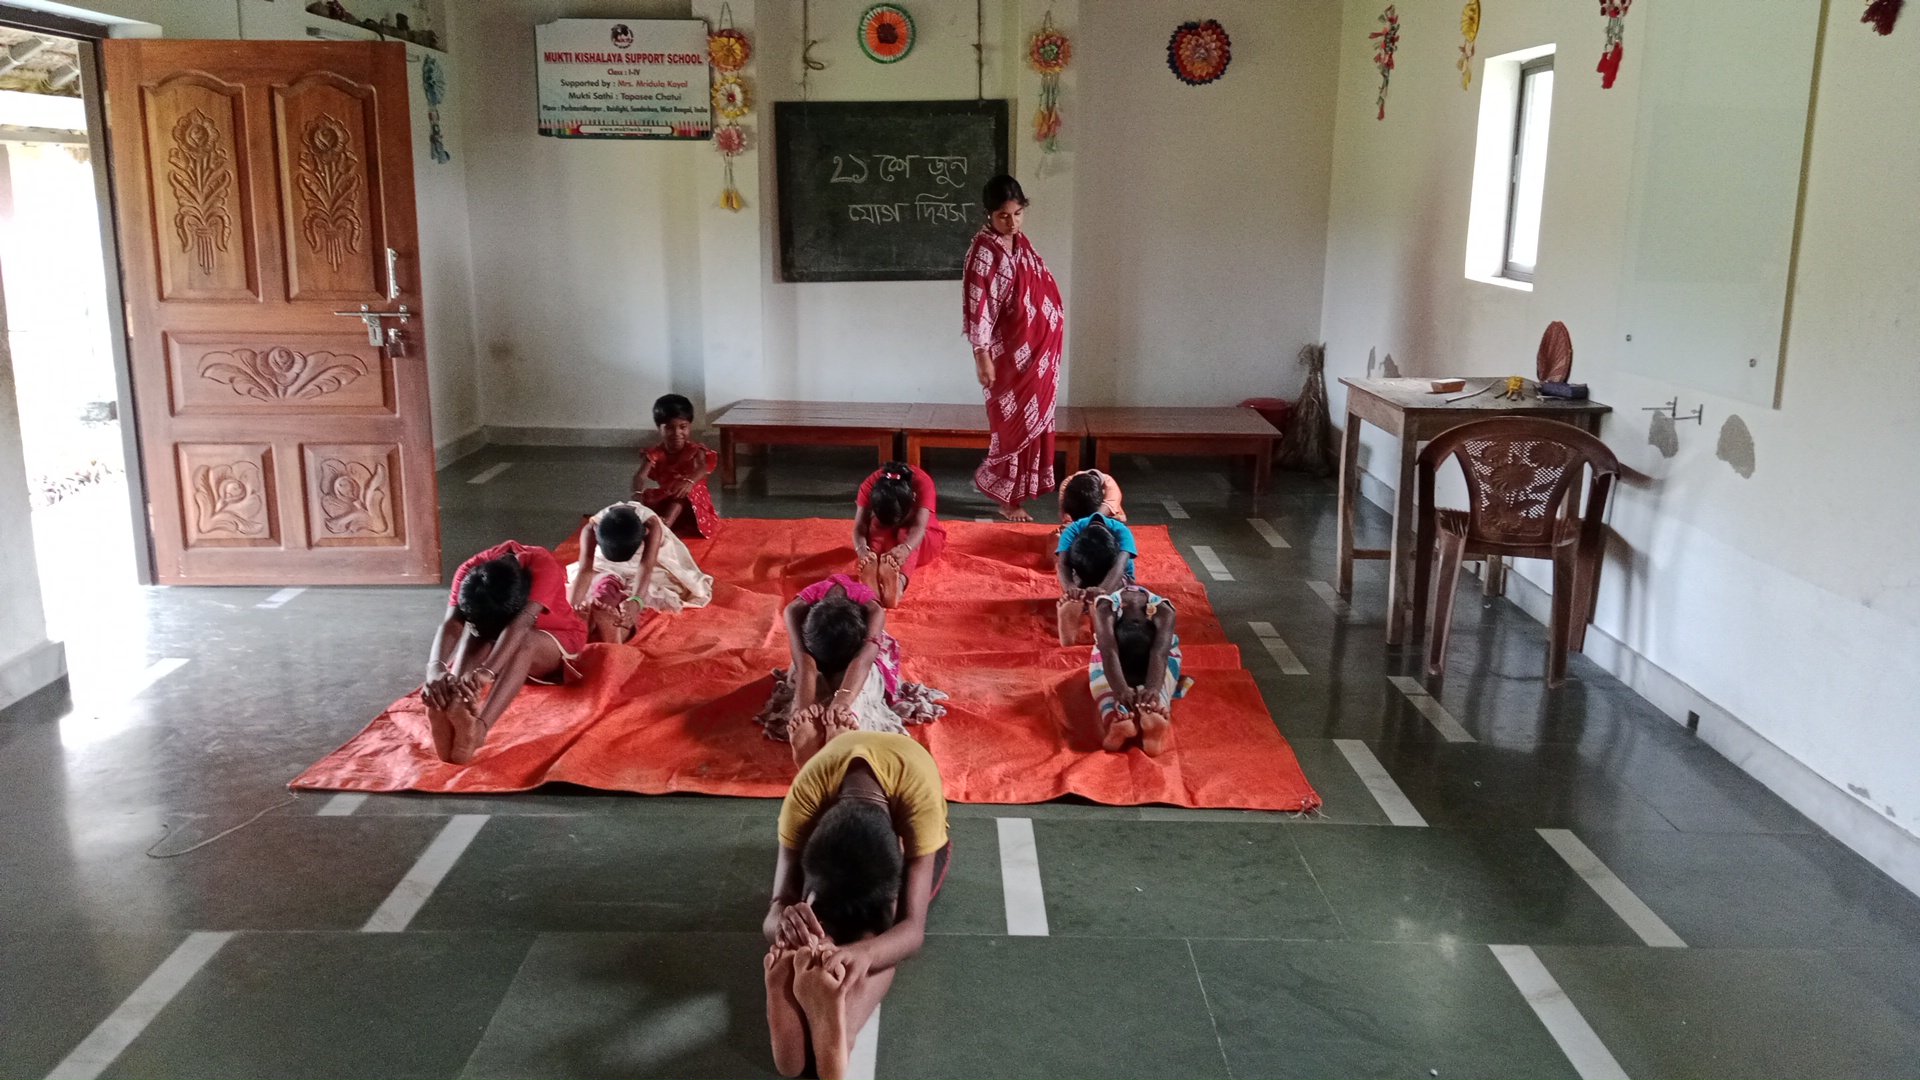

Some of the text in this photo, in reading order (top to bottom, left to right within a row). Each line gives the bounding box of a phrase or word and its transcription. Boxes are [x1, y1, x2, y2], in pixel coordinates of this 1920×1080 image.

[544, 51, 703, 64] MUKTI KISHALAYA SUPPORT SCHOOL
[560, 79, 600, 88] Supported
[601, 80, 611, 88] by
[636, 80, 665, 88] Mridula
[667, 80, 688, 89] Kayal
[621, 93, 653, 101] Tapasee
[830, 153, 968, 188] ২১ শে জুন
[848, 193, 975, 226] যোগ দিবস
